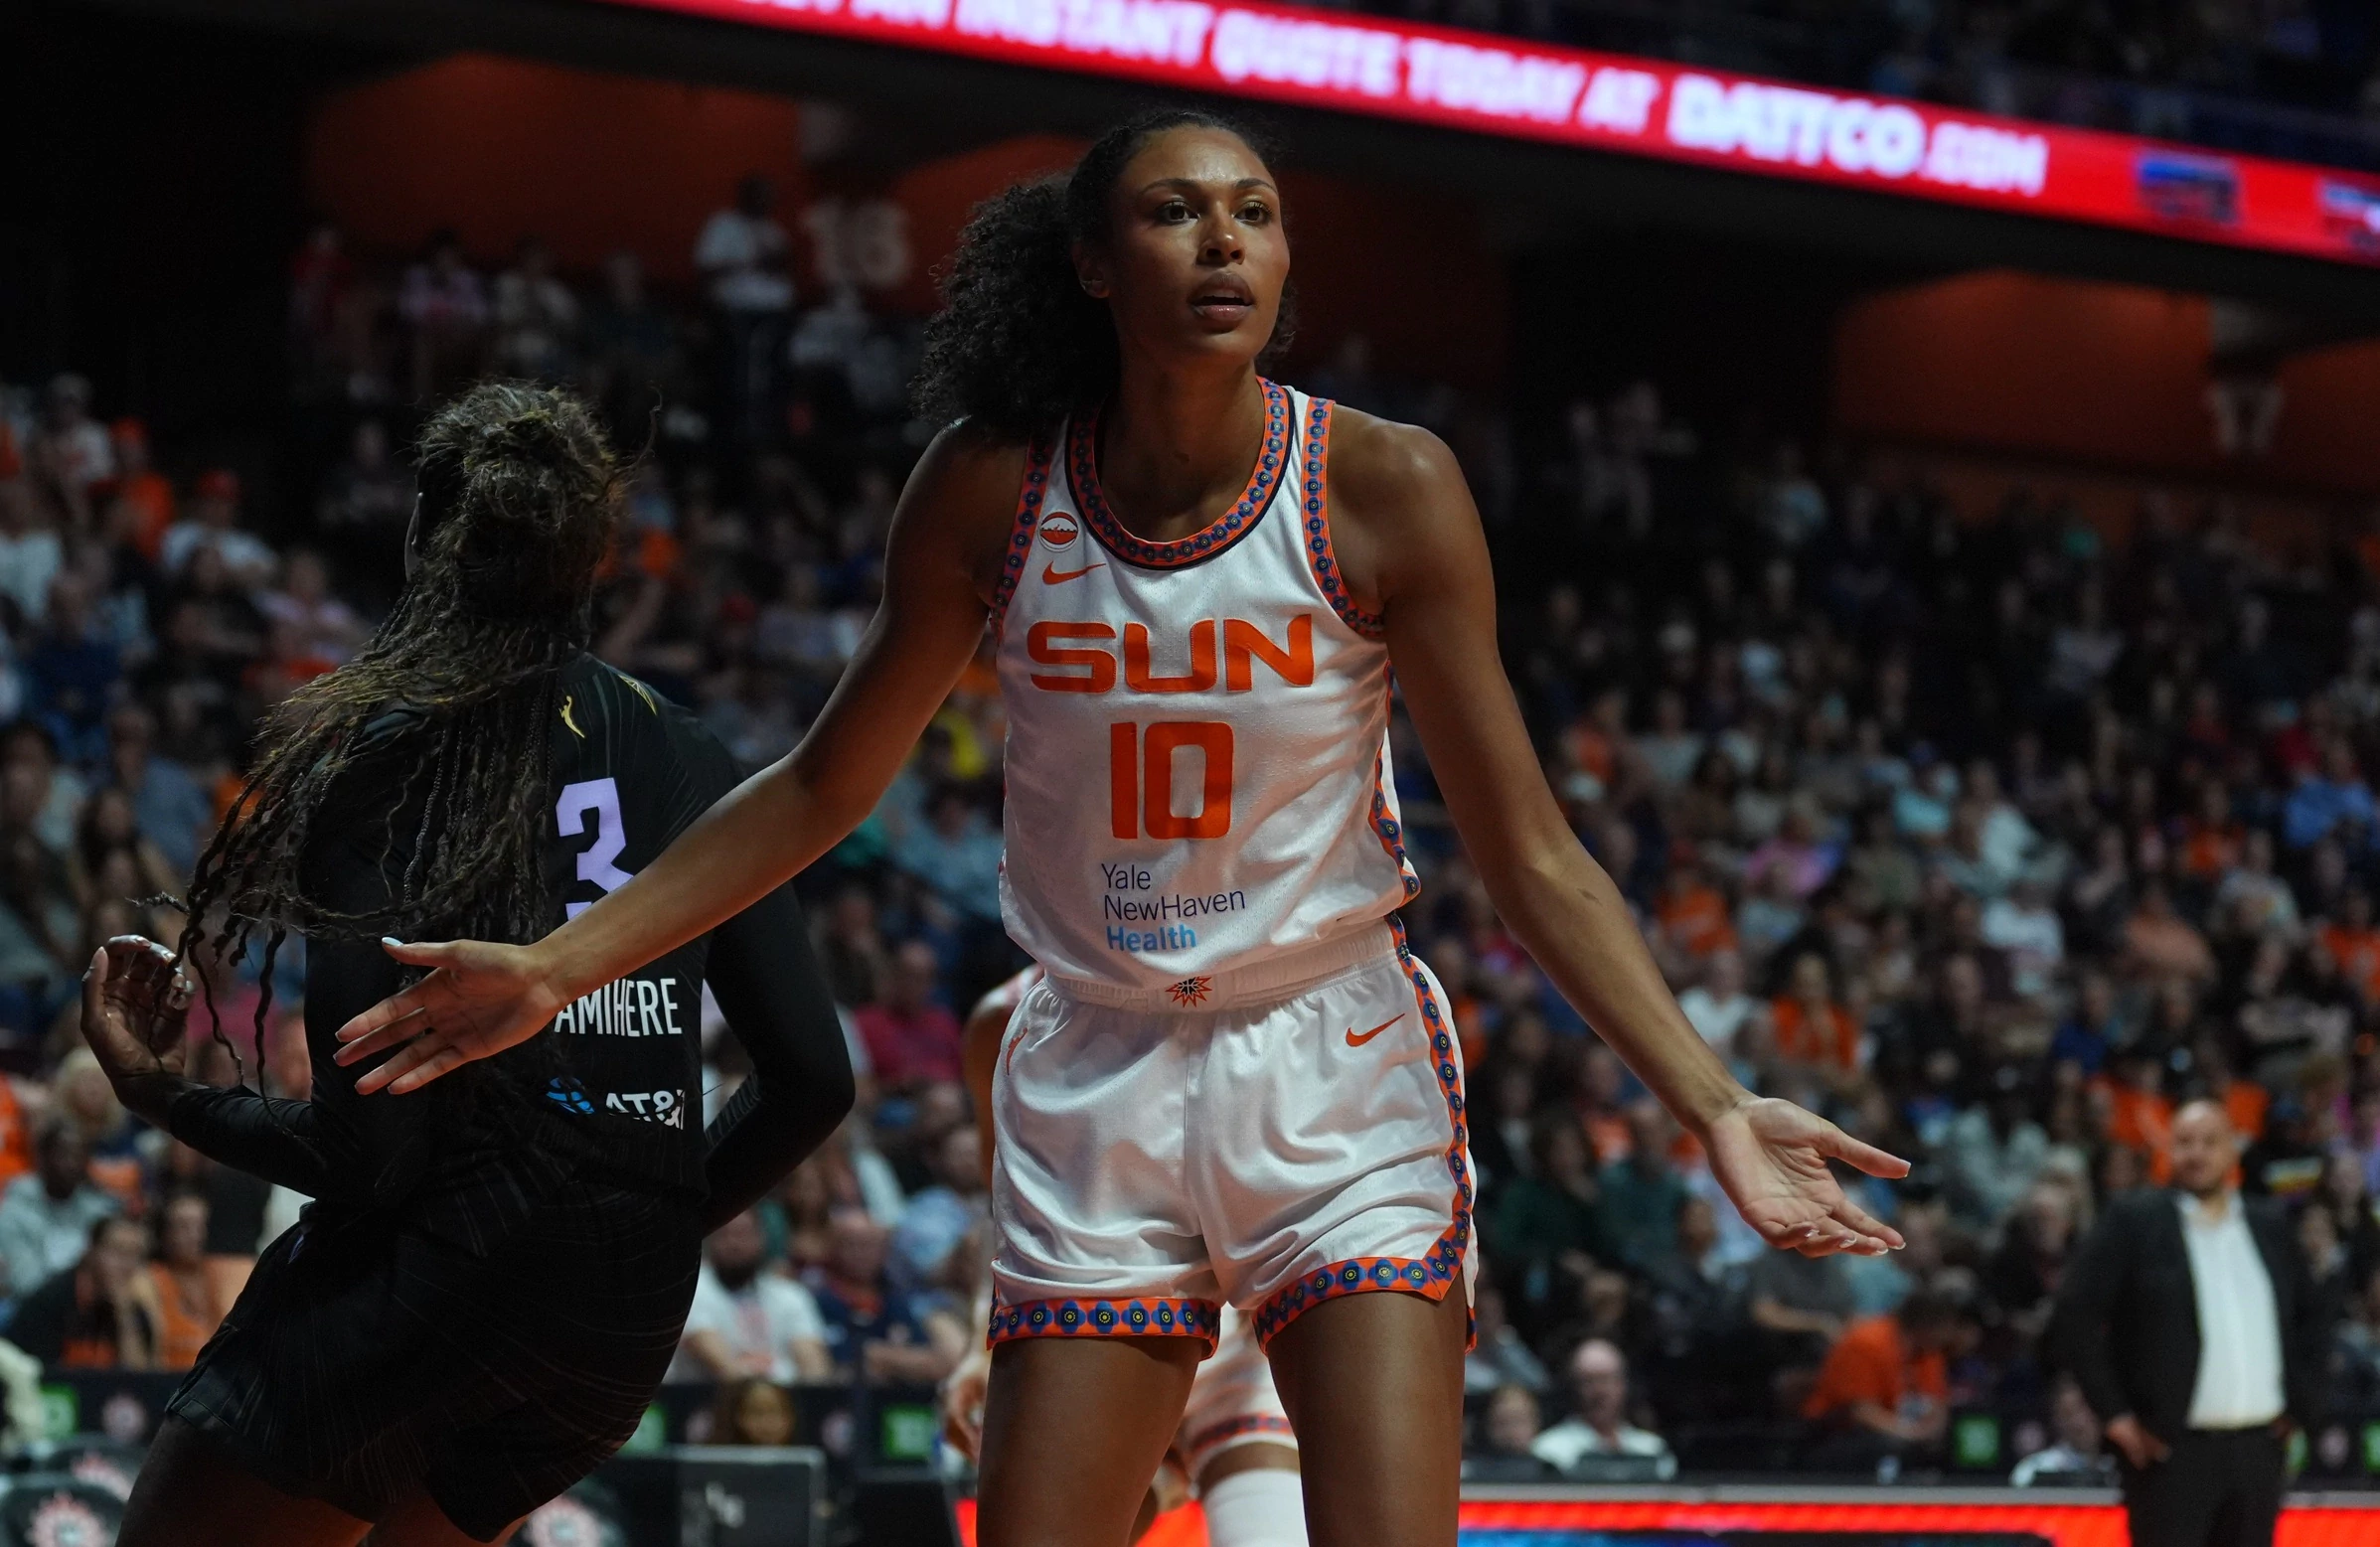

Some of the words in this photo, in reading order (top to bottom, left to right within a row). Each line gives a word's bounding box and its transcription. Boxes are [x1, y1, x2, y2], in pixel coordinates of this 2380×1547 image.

[1405, 38, 1585, 125] TODAY
[1577, 68, 1660, 135] AT
[1027, 614, 1315, 694] SUN
[1110, 722, 1234, 840] 10
[555, 778, 634, 922] 3
[1101, 863, 1152, 890] Yale
[1103, 888, 1246, 921] NewHaven
[1106, 923, 1197, 954] Health
[554, 977, 683, 1036] AMIHERE
